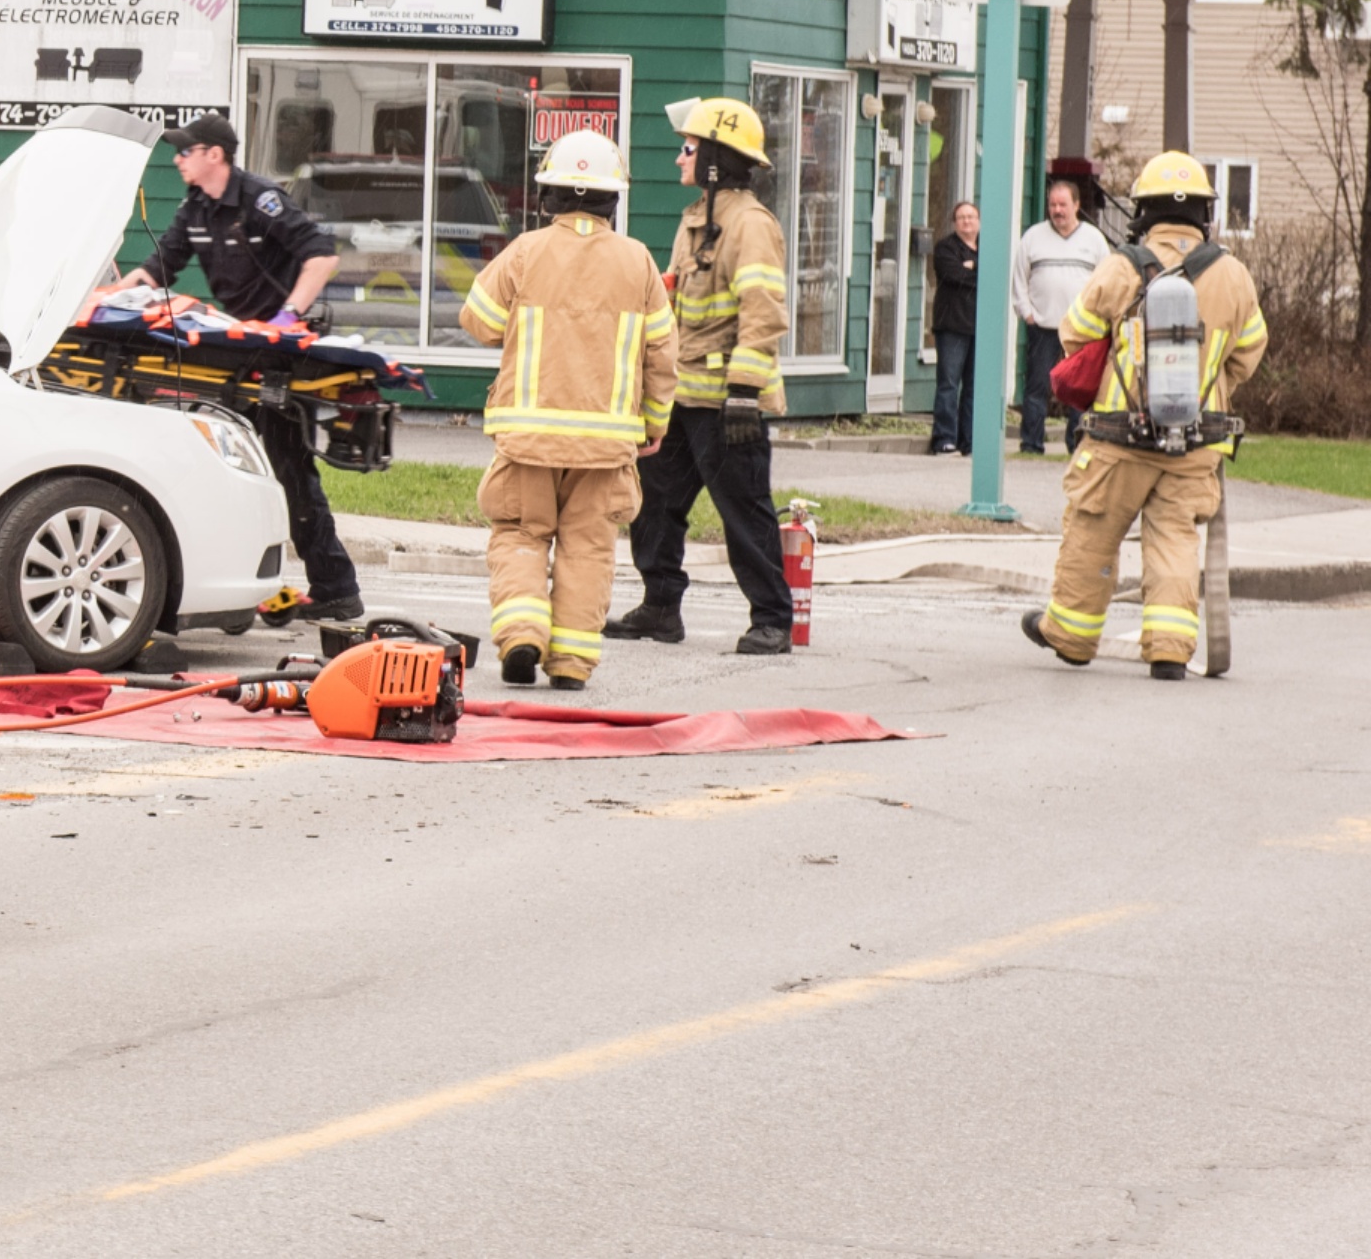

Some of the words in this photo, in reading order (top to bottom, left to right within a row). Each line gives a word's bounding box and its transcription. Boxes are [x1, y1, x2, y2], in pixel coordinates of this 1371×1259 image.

[370, 10, 399, 18] SERVICE
[371, 22, 423, 33] 374-7998
[436, 25, 514, 36] 450-370-1120
[916, 41, 955, 63] 370-1120
[535, 110, 618, 143] OUVERT
[714, 110, 739, 133] 14
